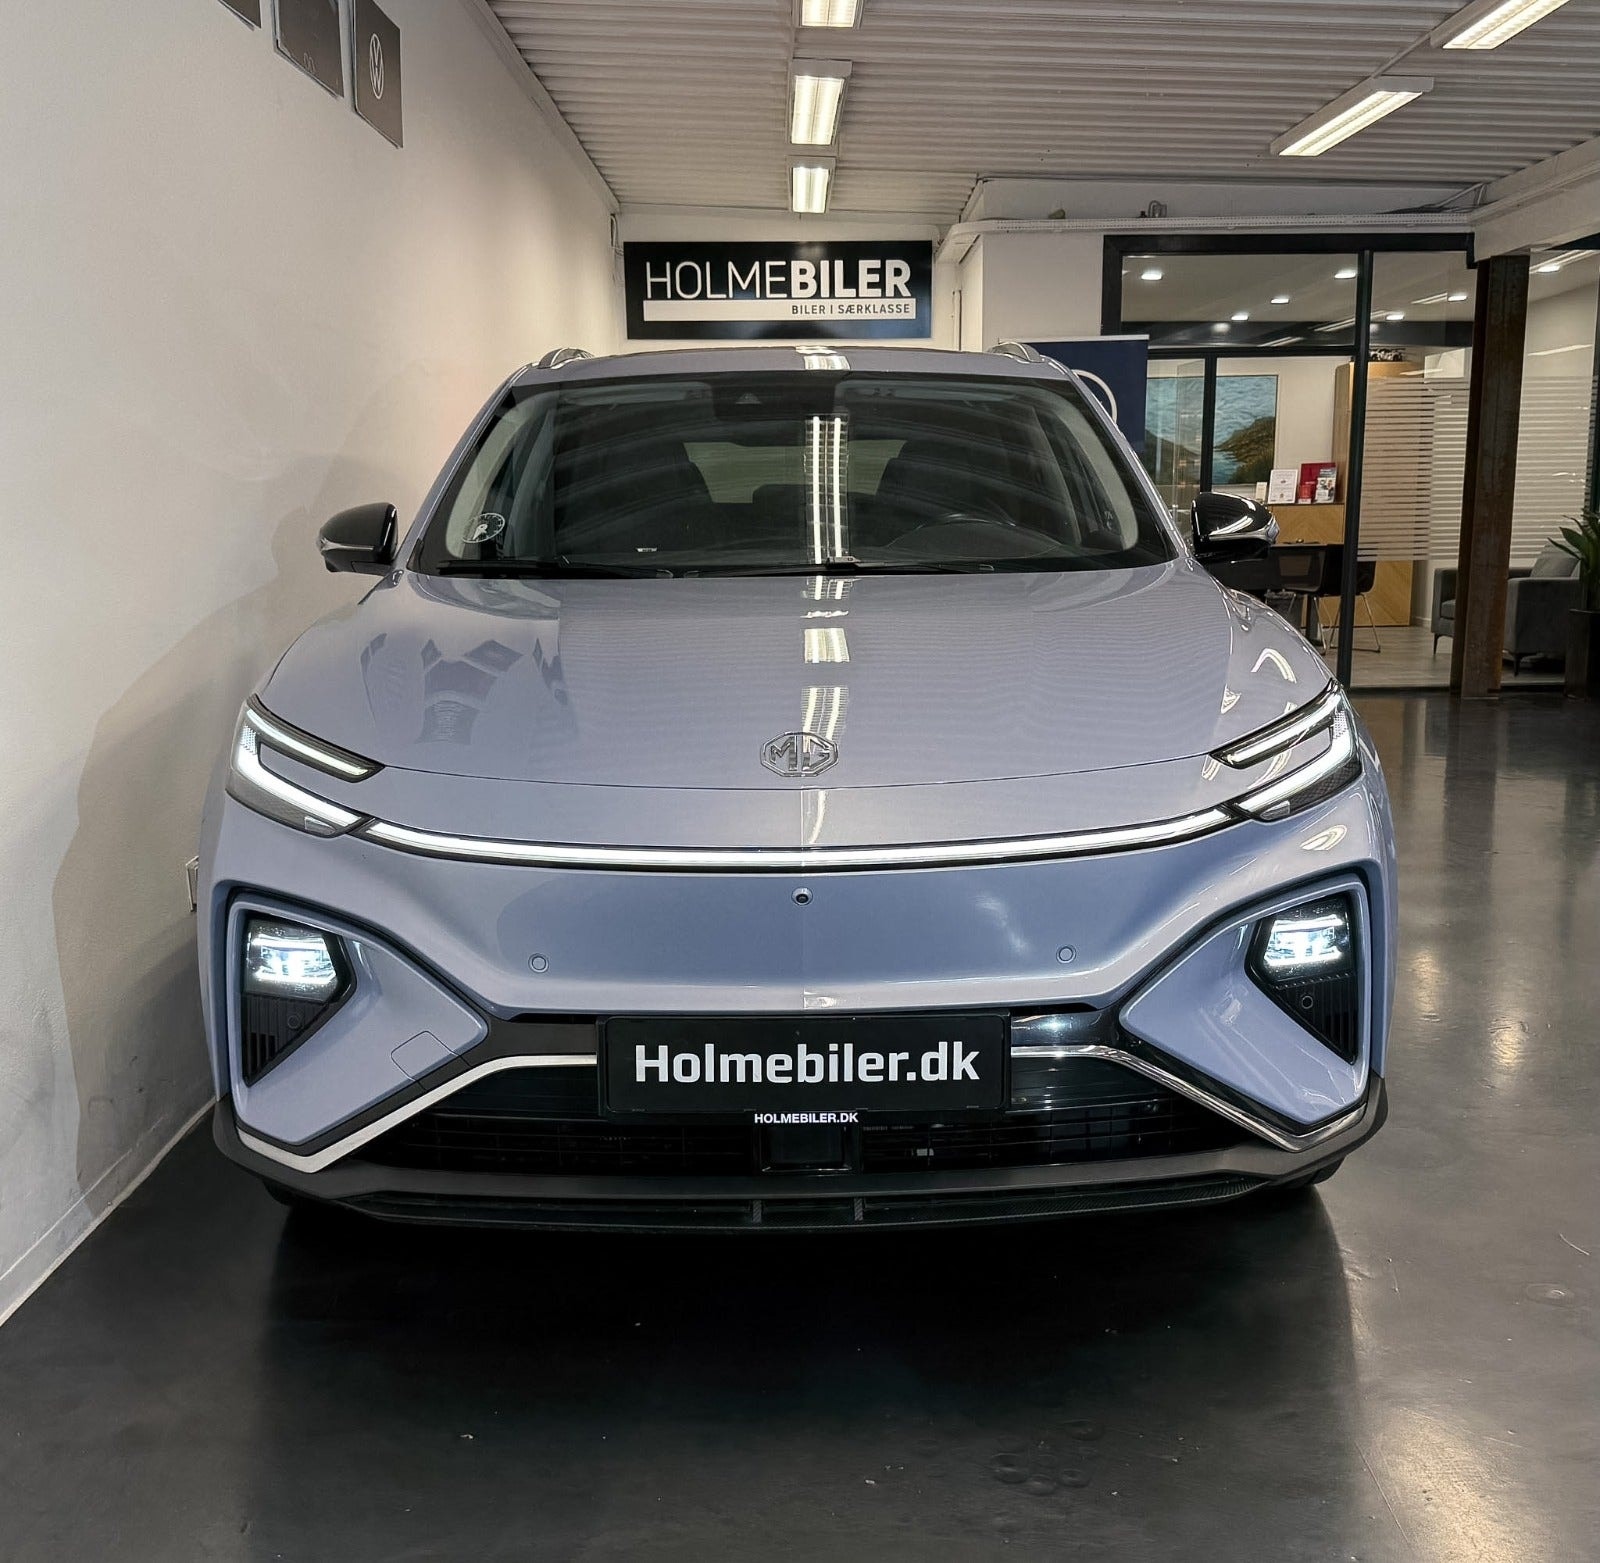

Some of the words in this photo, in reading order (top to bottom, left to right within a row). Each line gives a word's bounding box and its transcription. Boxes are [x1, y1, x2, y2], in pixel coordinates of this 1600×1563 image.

[646, 259, 912, 299] HOLMEBILER
[791, 305, 826, 315] BILER
[838, 303, 910, 315] SÆRKLASSE
[768, 735, 833, 772] MG
[635, 1041, 980, 1083] Holmebiler.dk
[754, 1112, 859, 1124] HOLMEBILER.DK
